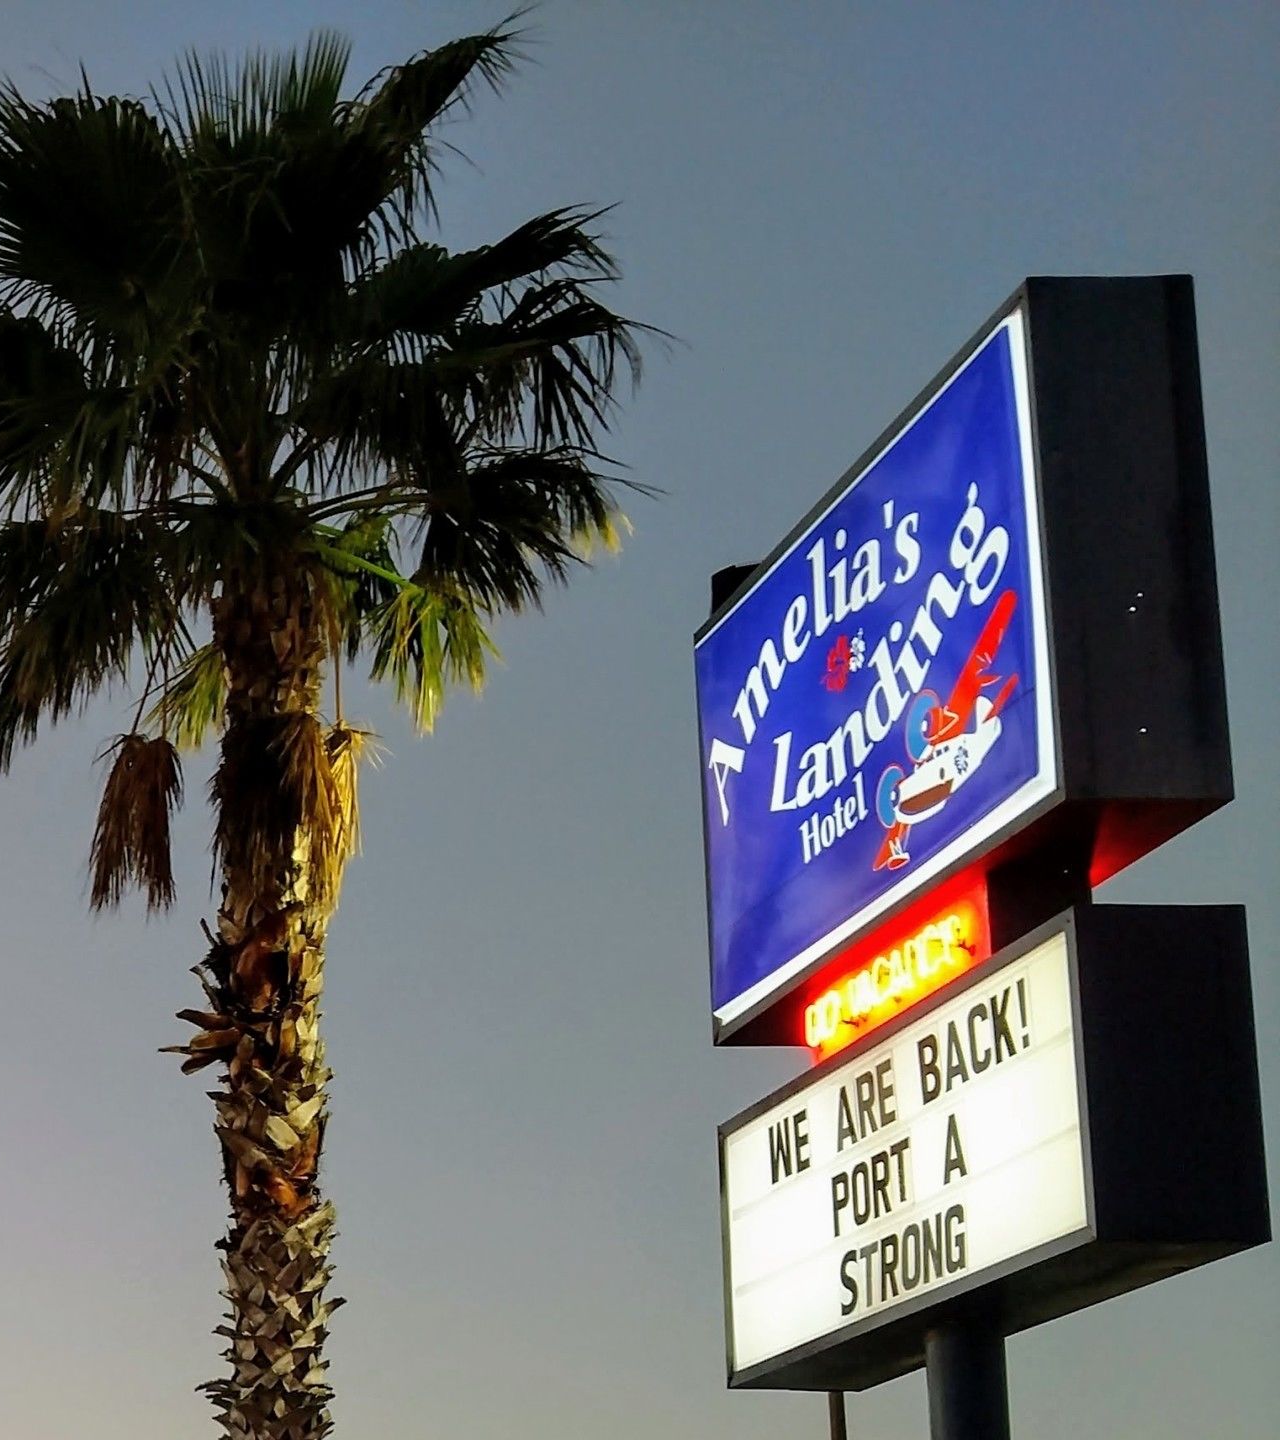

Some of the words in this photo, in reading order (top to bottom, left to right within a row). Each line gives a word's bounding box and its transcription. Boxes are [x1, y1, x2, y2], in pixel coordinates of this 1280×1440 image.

[708, 500, 921, 827] Amelia's
[769, 481, 1011, 813] Landing
[799, 770, 869, 864] Hotel
[767, 1108, 811, 1184] WE
[836, 1056, 898, 1153] ARE
[916, 977, 1030, 1105] BACK!
[831, 1138, 910, 1238] PORT
[943, 1114, 968, 1186] A
[840, 1203, 967, 1316] STRONG
